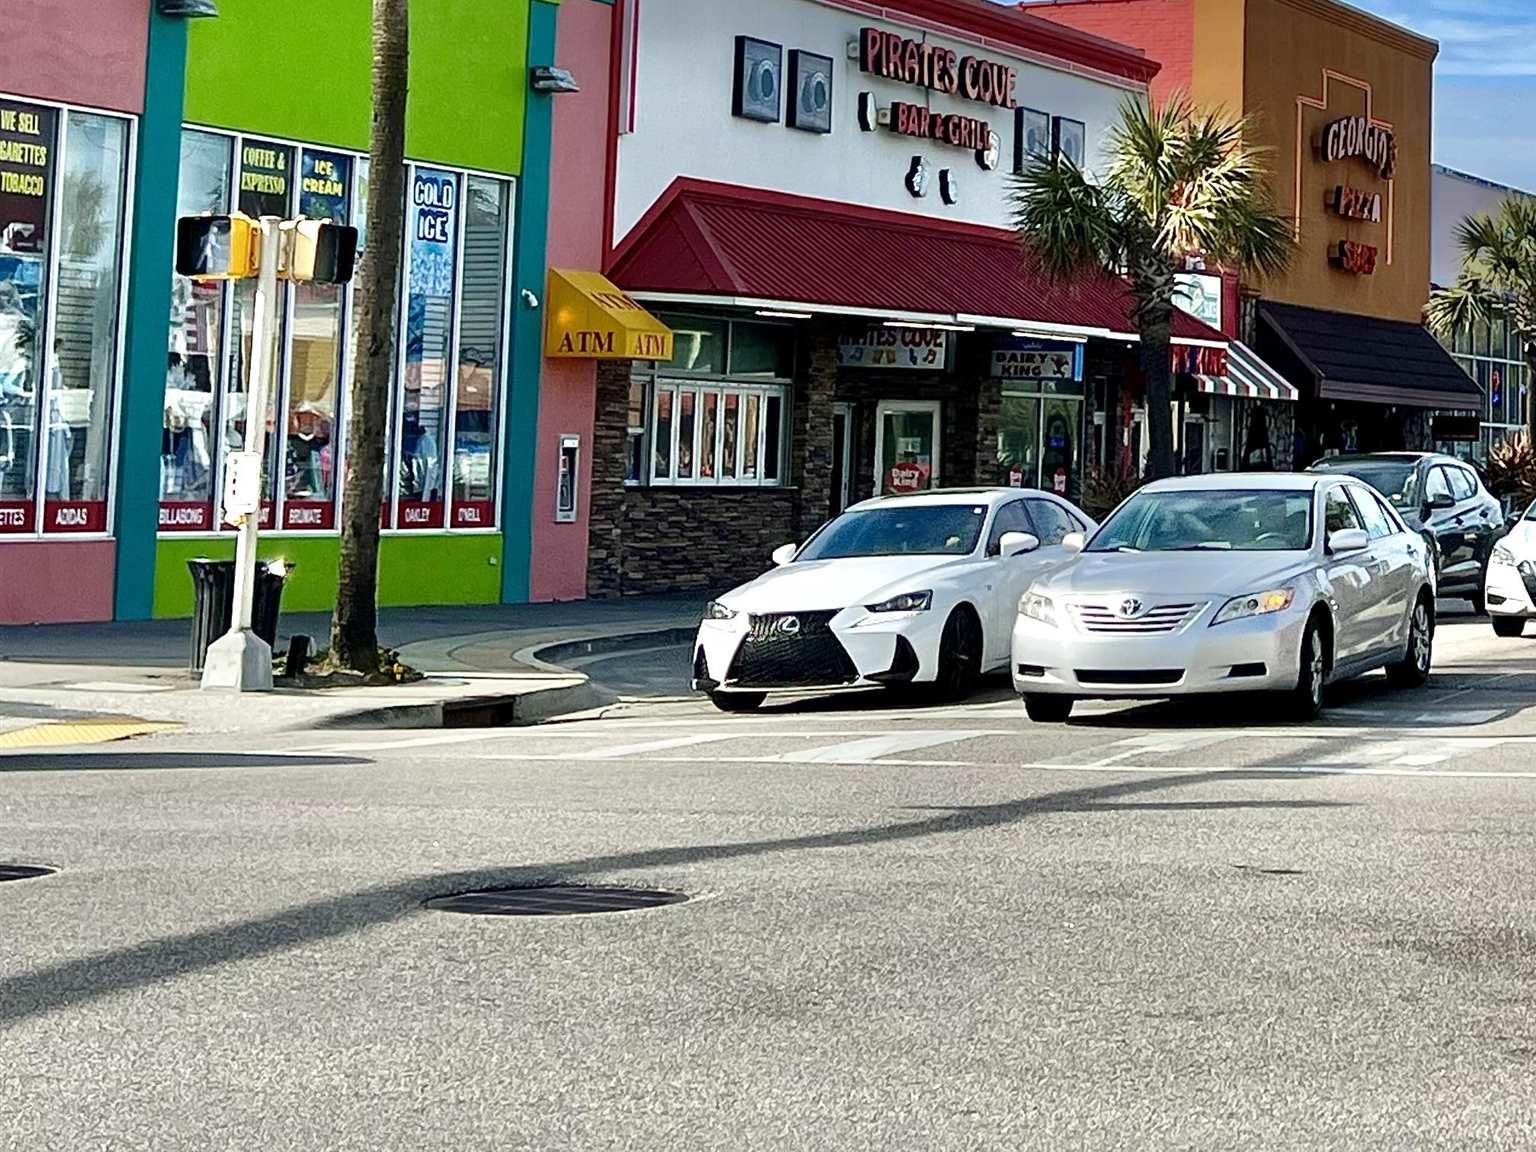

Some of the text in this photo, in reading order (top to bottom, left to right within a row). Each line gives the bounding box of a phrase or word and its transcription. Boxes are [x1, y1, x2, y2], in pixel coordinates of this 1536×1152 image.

[862, 28, 1018, 108] PIRATES COVE
[0, 110, 40, 135] WE SELL
[892, 102, 991, 150] BAR & GRILL
[243, 147, 286, 170] COFFEE &
[314, 160, 334, 175] ICE
[1, 171, 44, 196] TOBACCO
[241, 171, 285, 195] ESPRESSO
[303, 177, 343, 197] CREAM
[414, 178, 453, 209] COLD
[1337, 186, 1381, 224] PIZZA
[417, 214, 448, 241] ICE
[558, 331, 615, 354] ATM
[635, 334, 666, 356] ATM
[996, 351, 1048, 364] DAIRY
[1001, 364, 1042, 376] KING
